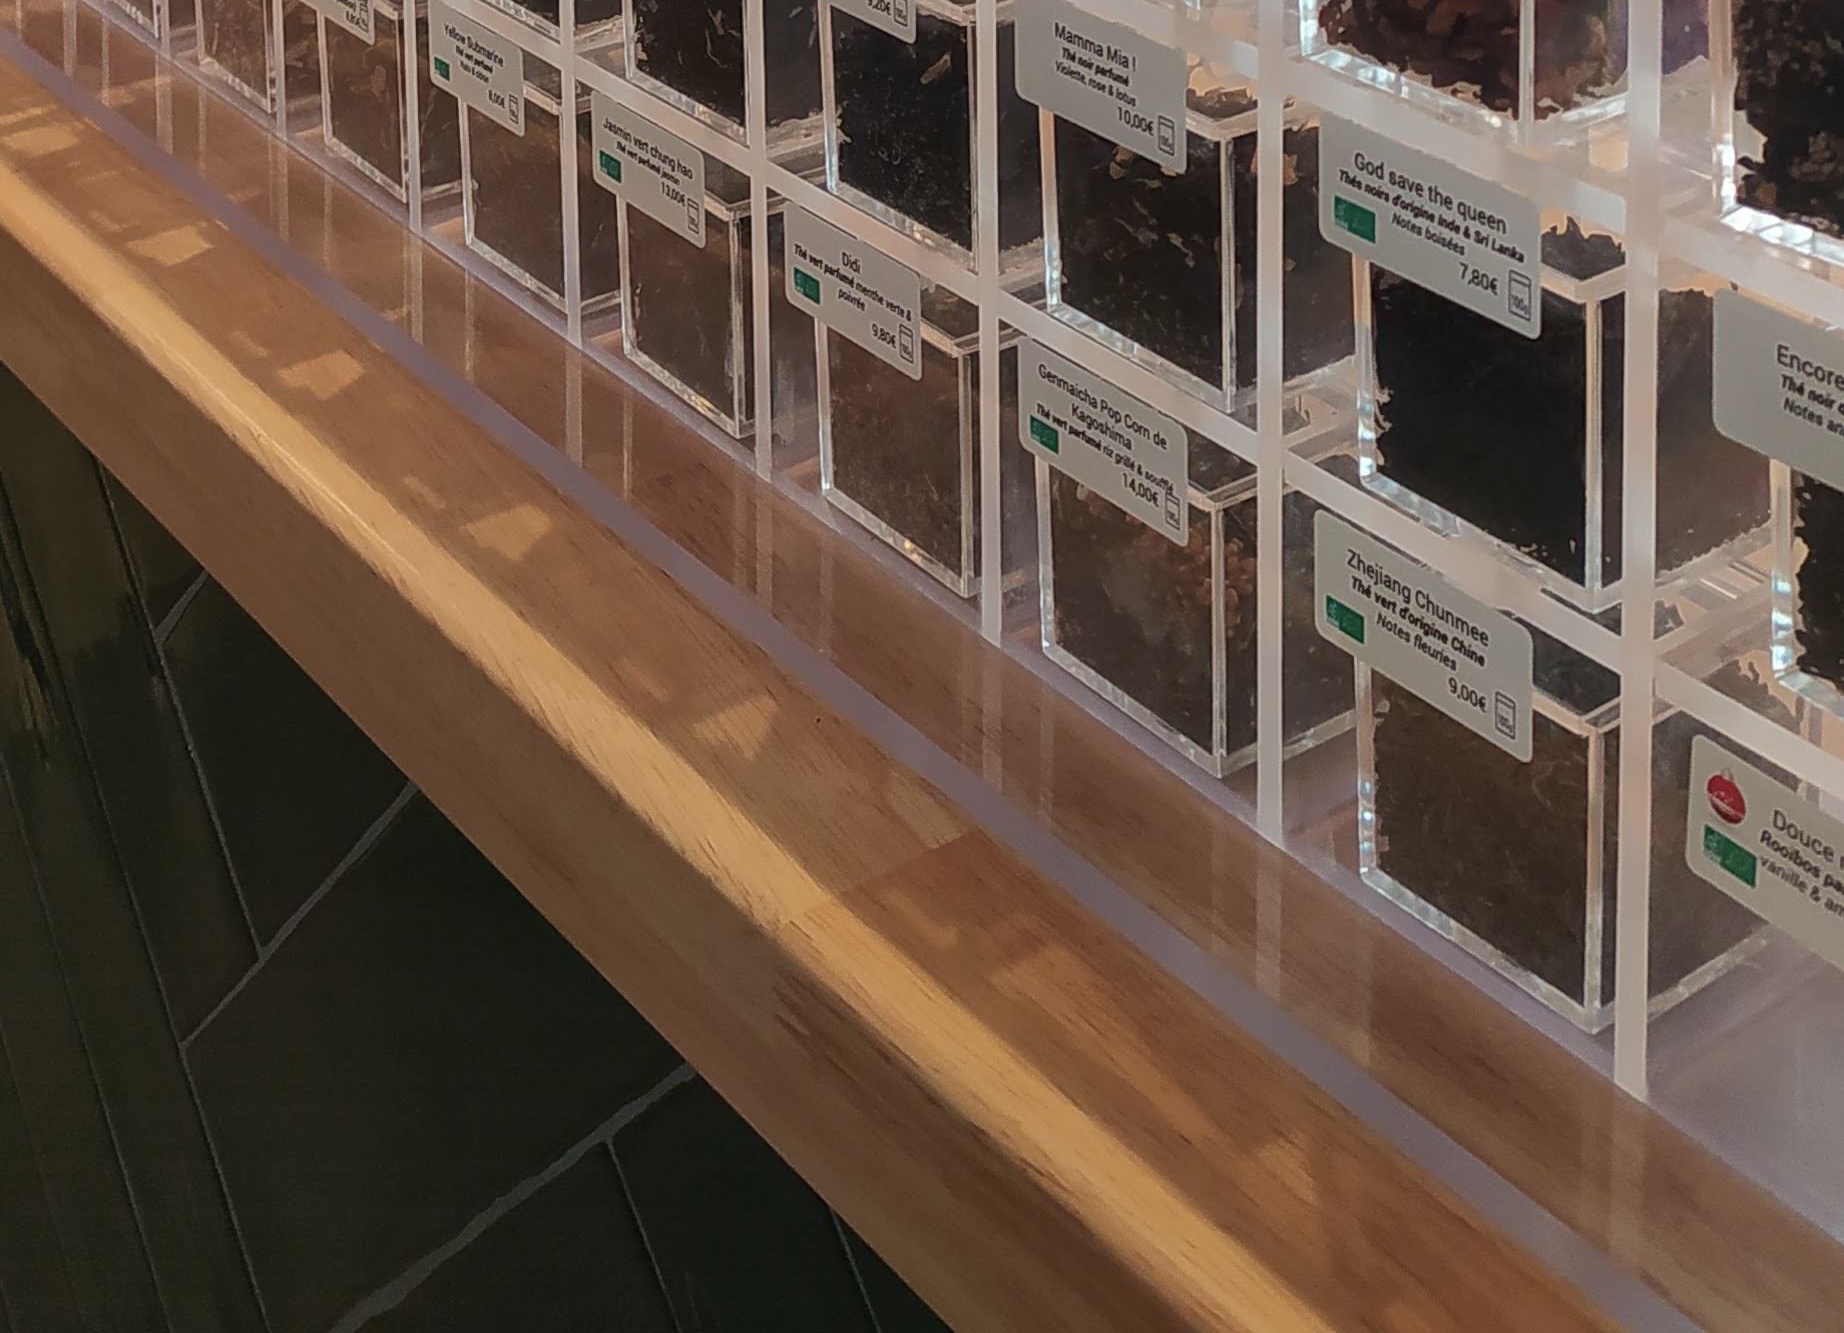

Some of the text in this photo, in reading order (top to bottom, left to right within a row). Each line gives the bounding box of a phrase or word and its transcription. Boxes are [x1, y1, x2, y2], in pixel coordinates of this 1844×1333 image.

[1055, 22, 1103, 58] Mamma
[1107, 45, 1129, 69] Mia
[1062, 47, 1129, 88] Thé noir parfumé
[1055, 61, 1136, 107] Violette, rose & lotus
[1117, 106, 1154, 136] 10,00€
[603, 117, 693, 180] Jasmin vert chung hao
[1339, 168, 1525, 263] Thés noirs d'origine Inde & Sri Lanka
[1354, 152, 1507, 235] God save the queen
[1392, 212, 1465, 256] Notes boisées
[794, 243, 807, 261] Thé
[809, 254, 823, 270] vert
[824, 263, 855, 288] parfumé
[856, 282, 884, 306] menthe
[885, 299, 905, 318] verte
[842, 252, 861, 274] Didi
[1459, 261, 1498, 296] 7,80€
[872, 323, 896, 349] 9,80€
[1777, 344, 1844, 390] Encore
[1038, 363, 1167, 451] Genmaicha Pop Corn de
[1781, 374, 1805, 395] Thé
[1808, 389, 1835, 409] noir
[1784, 397, 1823, 426] Notes
[1037, 402, 1050, 419] Thé
[1052, 414, 1067, 431] vert
[1069, 423, 1102, 452] parfumé
[1103, 441, 1114, 458] riz
[1072, 403, 1132, 451] Kagoshima
[1122, 473, 1159, 507] 14,00€
[1347, 548, 1489, 647] Zhejiang Chunmee
[1351, 575, 1485, 667] Thé vert d'origine Chine
[1377, 612, 1457, 671] Notes fleuries
[1448, 677, 1487, 713] 9,00€
[1773, 810, 1834, 863] Douce
[1761, 857, 1820, 902] vanille &
